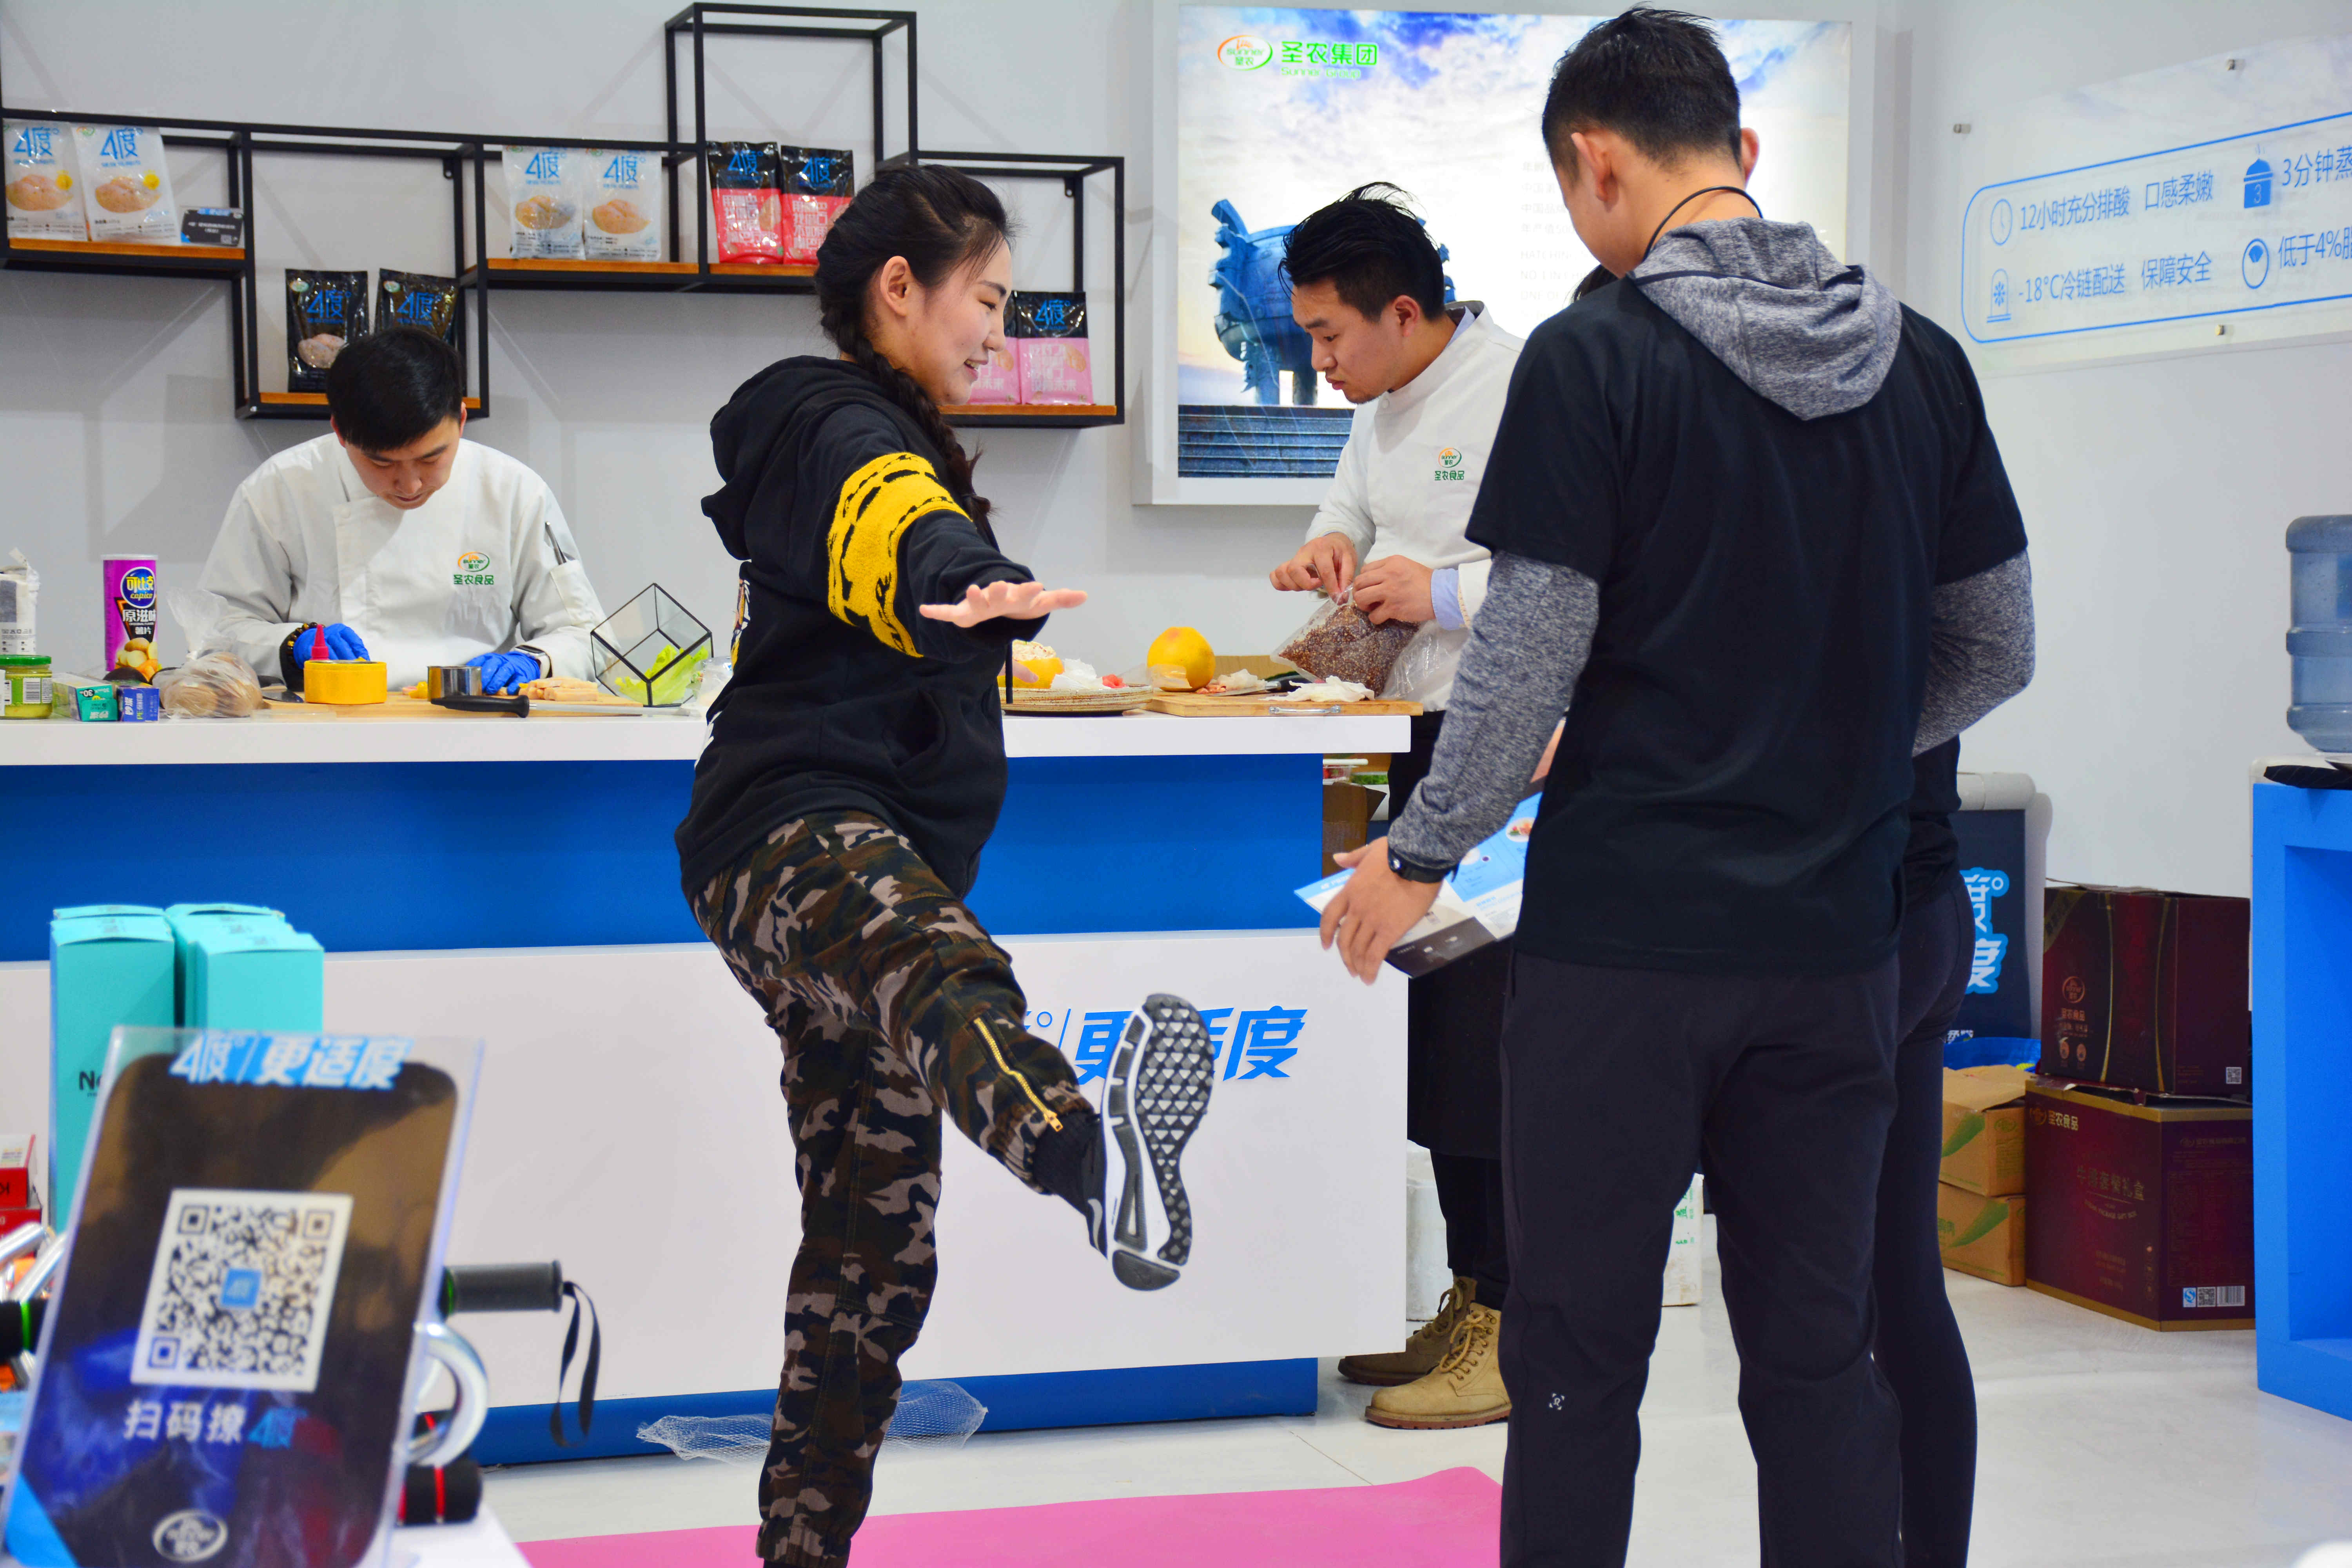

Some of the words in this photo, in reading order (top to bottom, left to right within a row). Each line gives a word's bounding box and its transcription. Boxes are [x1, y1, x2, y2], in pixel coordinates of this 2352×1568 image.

[1281, 41, 1377, 65] 圣农集团
[1281, 67, 1321, 76] Sunner
[1326, 67, 1361, 79] Group
[2020, 187, 2131, 230] 12小时充分排酸
[2144, 169, 2214, 211] 口感柔嫩
[2018, 263, 2125, 303] -18°C冷链配送
[2141, 250, 2212, 290] 保障安全
[1434, 470, 1465, 481] 圣农食品
[125, 575, 154, 593] 可比克
[453, 574, 494, 585] 圣农食品
[1074, 1005, 1308, 1085] 更度
